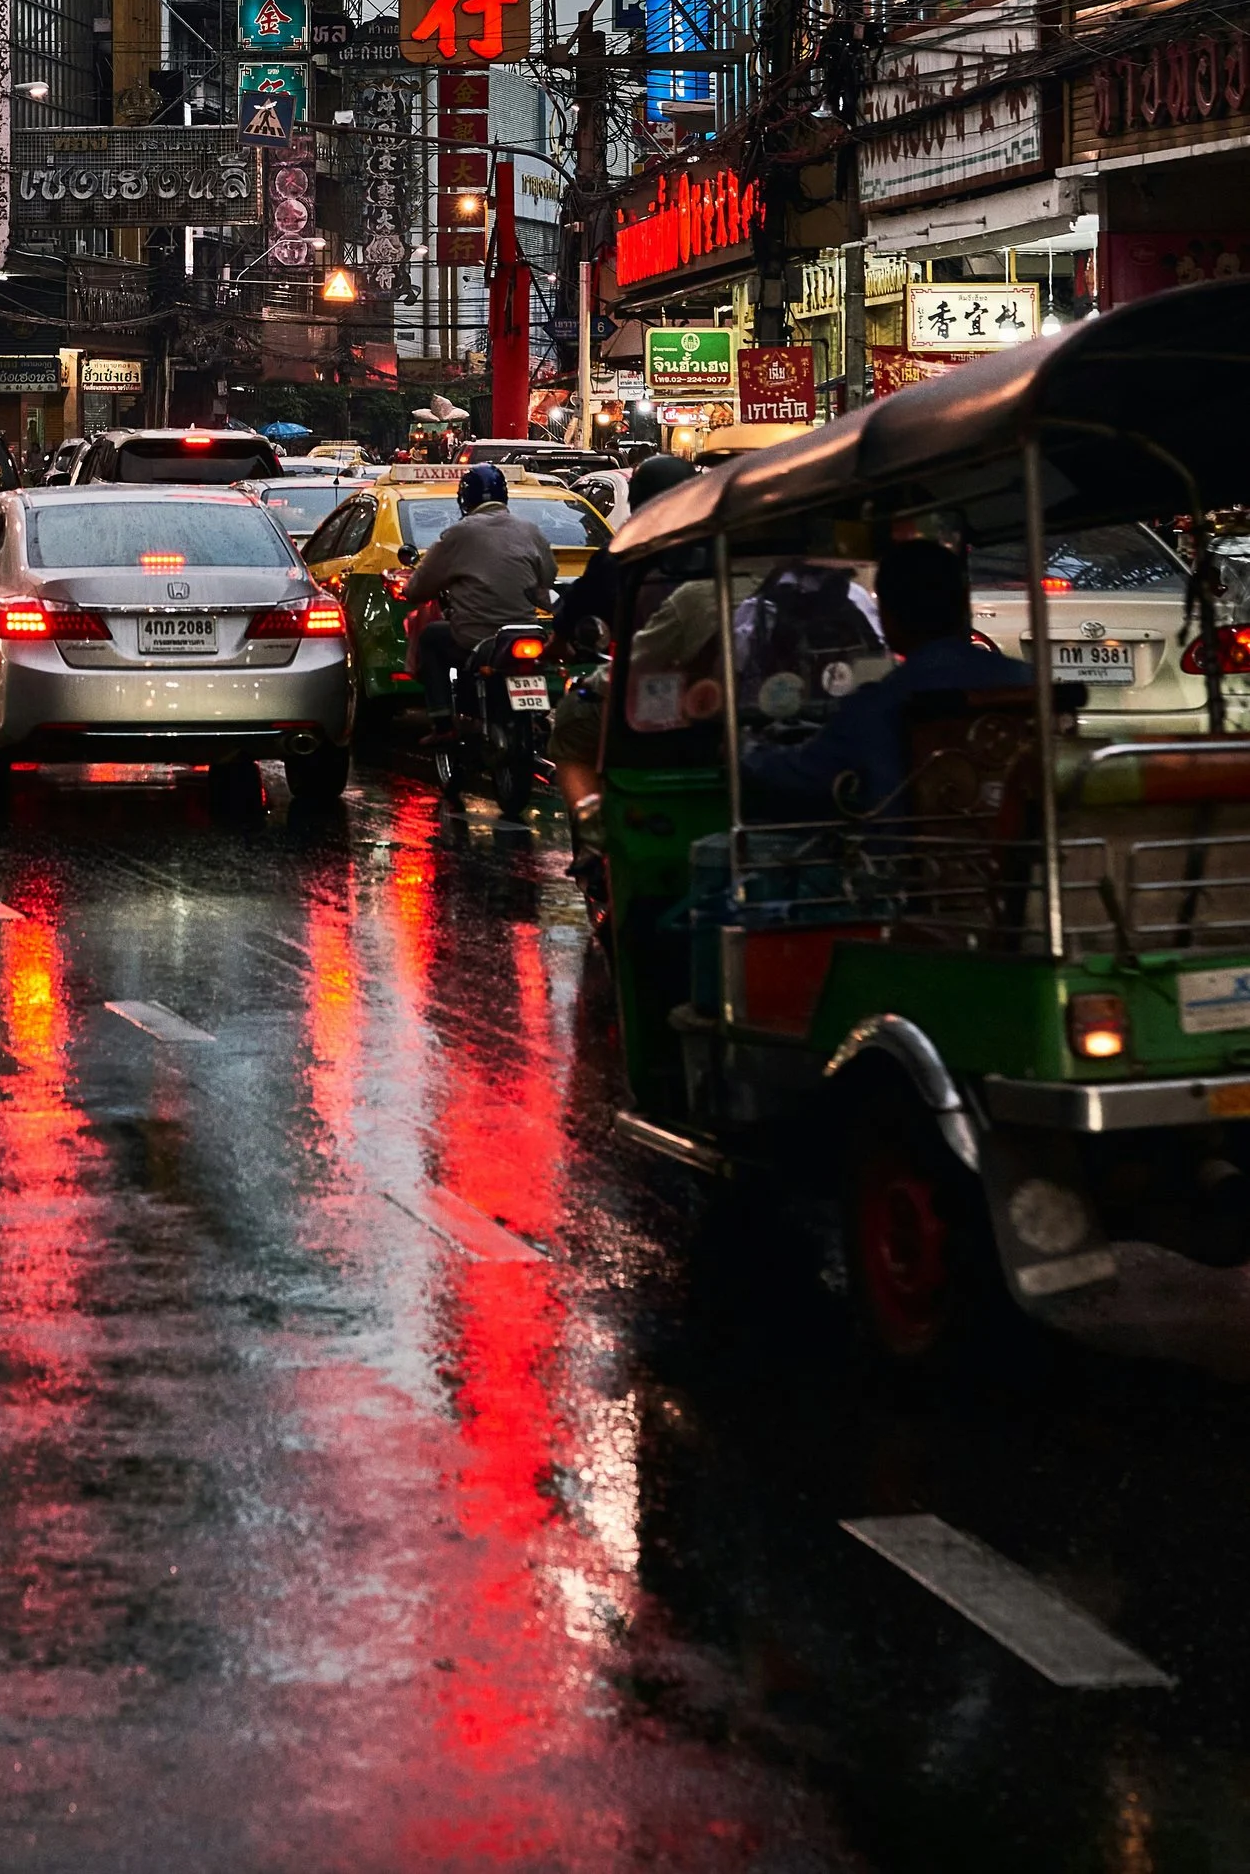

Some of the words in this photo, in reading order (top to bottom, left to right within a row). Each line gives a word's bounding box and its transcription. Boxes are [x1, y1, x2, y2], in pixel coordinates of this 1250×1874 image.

[597, 321, 605, 333] 6
[653, 352, 729, 373] จินฮั้วเฮง
[747, 396, 809, 420] เกาลัด
[177, 620, 213, 635] 2088
[1091, 647, 1129, 664] 9381
[518, 697, 543, 707] 302
